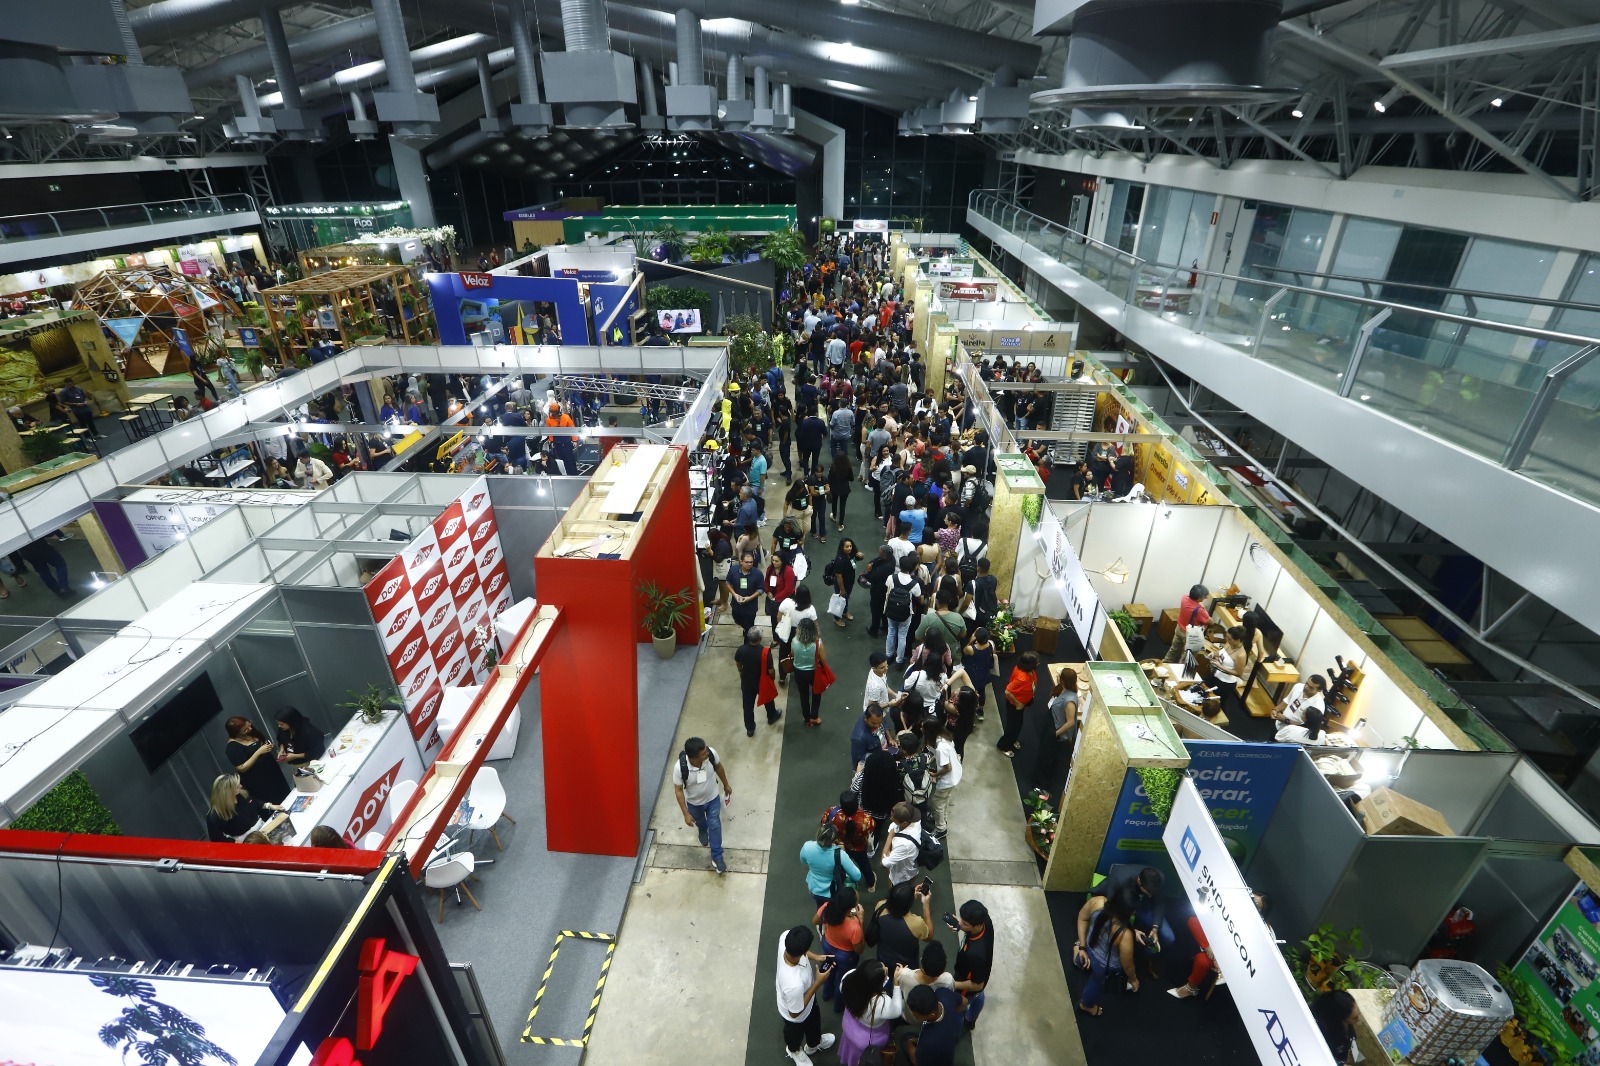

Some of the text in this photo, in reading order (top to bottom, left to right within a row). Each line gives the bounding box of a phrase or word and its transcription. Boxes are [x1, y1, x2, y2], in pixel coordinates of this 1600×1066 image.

[463, 275, 490, 287] Veloz
[12, 314, 88, 340] CASTANHAL
[445, 520, 458, 535] DOW
[477, 524, 489, 538] DOW
[452, 548, 466, 565] DOW
[484, 550, 495, 565] DOW
[381, 579, 399, 600] DOW
[424, 577, 439, 596] DOW
[460, 577, 472, 593] DOW
[489, 576, 501, 591] DOW
[432, 606, 448, 626] DOW
[467, 603, 480, 620] DOW
[392, 610, 409, 633] DOW
[402, 641, 419, 663] DOW
[440, 634, 455, 653] DOW
[449, 661, 463, 680] DOW
[411, 670, 427, 694] DOW
[420, 697, 437, 719] DOW
[346, 772, 392, 844] DOW
[1125, 819, 1147, 827] Faça
[1201, 865, 1256, 979] SINDUSCON
[1577, 931, 1598, 954] Seguro
